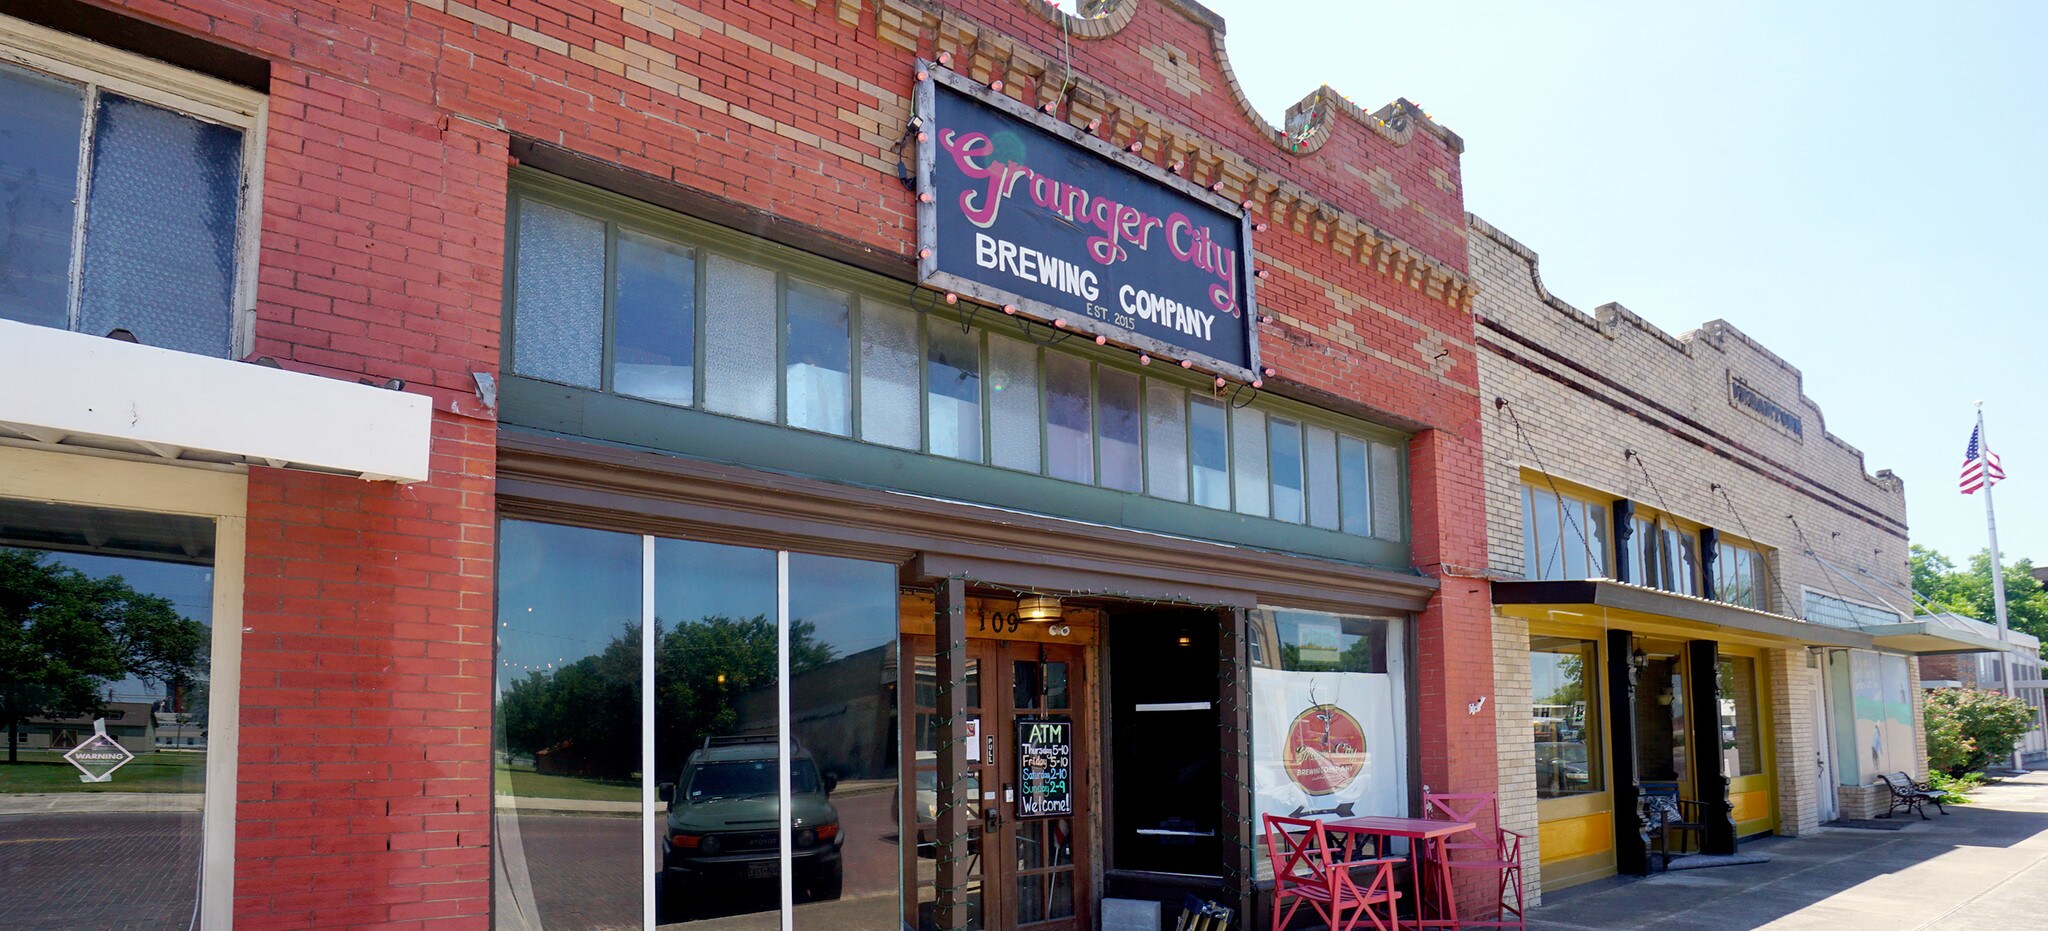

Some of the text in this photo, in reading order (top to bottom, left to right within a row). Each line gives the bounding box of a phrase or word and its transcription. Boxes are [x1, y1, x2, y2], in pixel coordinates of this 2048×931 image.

[939, 127, 1241, 319] Granger City
[975, 232, 1214, 341] BREWING COMPANY
[1086, 303, 1135, 330] EST. 2015
[979, 608, 1018, 633] 109
[1029, 724, 1062, 744] ATM
[1022, 743, 1069, 759] Thursday 5-10
[1022, 755, 1068, 769] Friday 5-10
[1022, 768, 1067, 783] Saturday 2-10
[1022, 780, 1066, 797] Sunday 2-9
[1022, 793, 1070, 813] Welcome!
